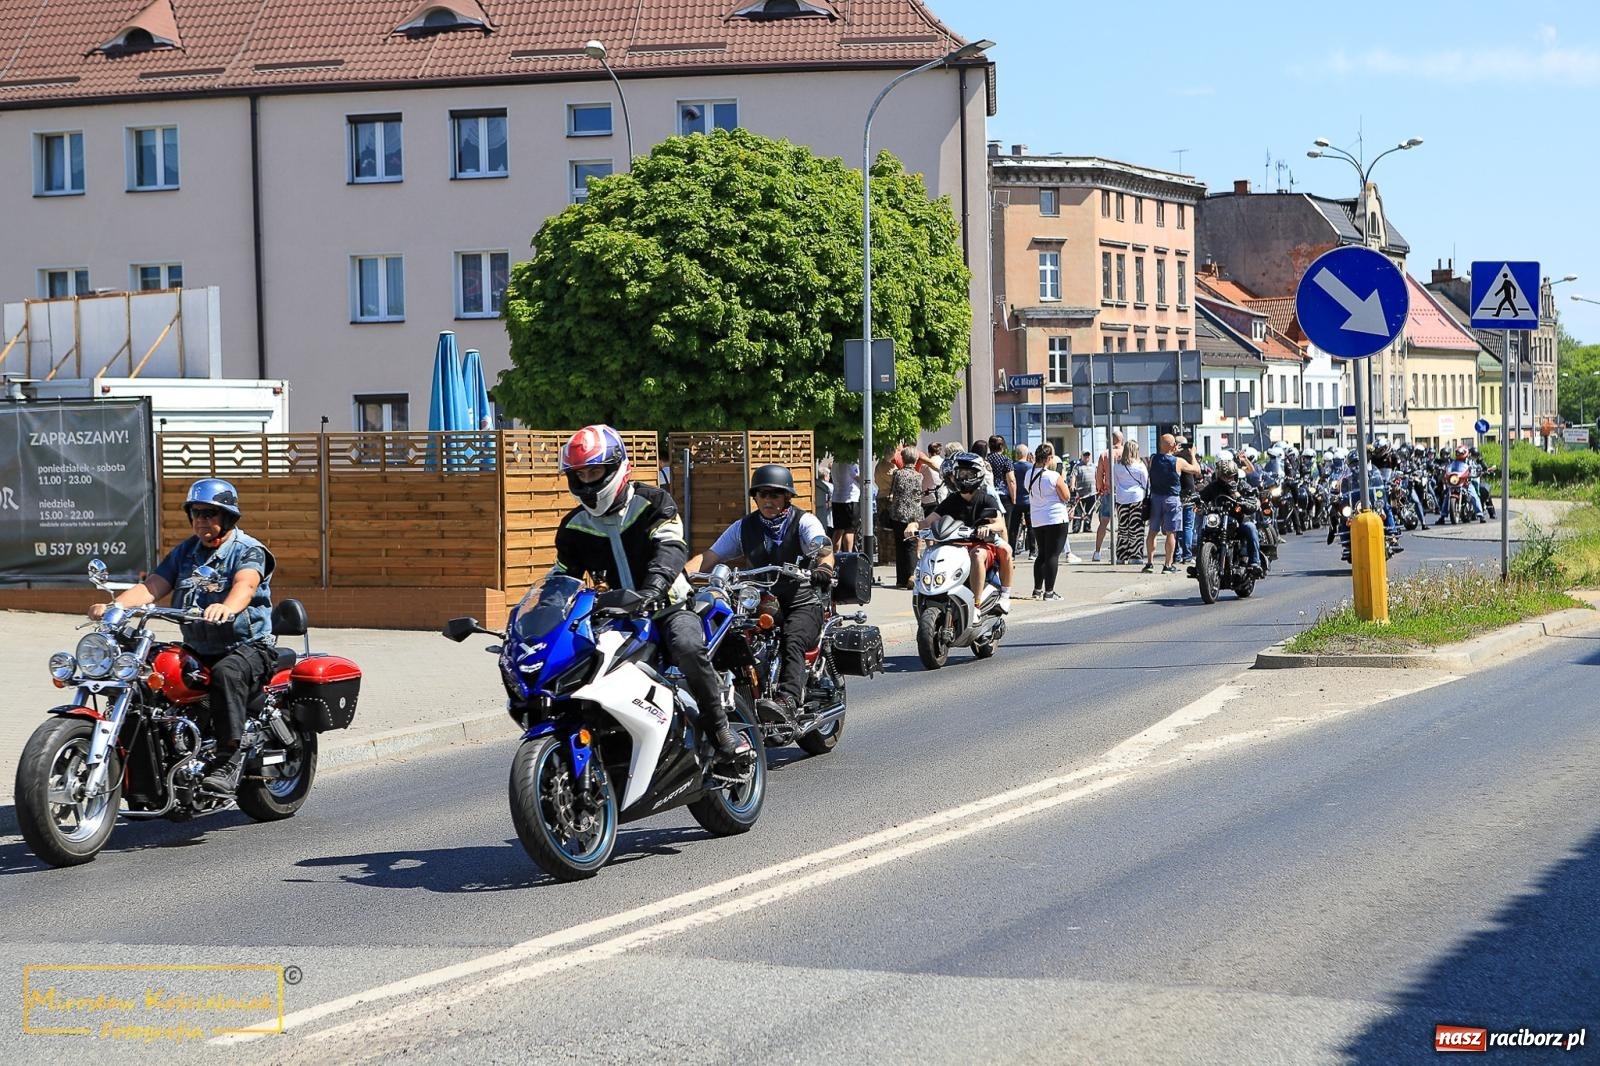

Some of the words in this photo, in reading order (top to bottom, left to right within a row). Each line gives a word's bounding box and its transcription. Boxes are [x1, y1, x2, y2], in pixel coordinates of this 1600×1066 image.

[29, 430, 130, 446] ZAPRASZAMY!
[37, 463, 90, 475] poniedziałek
[96, 462, 126, 473] sobota
[38, 475, 62, 485] 11.00
[68, 475, 92, 485] 23.00
[39, 499, 76, 509] niedziela
[40, 511, 64, 521] 15.00
[70, 510, 95, 520] 22.00
[50, 543, 73, 555] 537
[75, 542, 100, 555] 891
[102, 541, 127, 555] 962
[632, 698, 664, 720] BLADE
